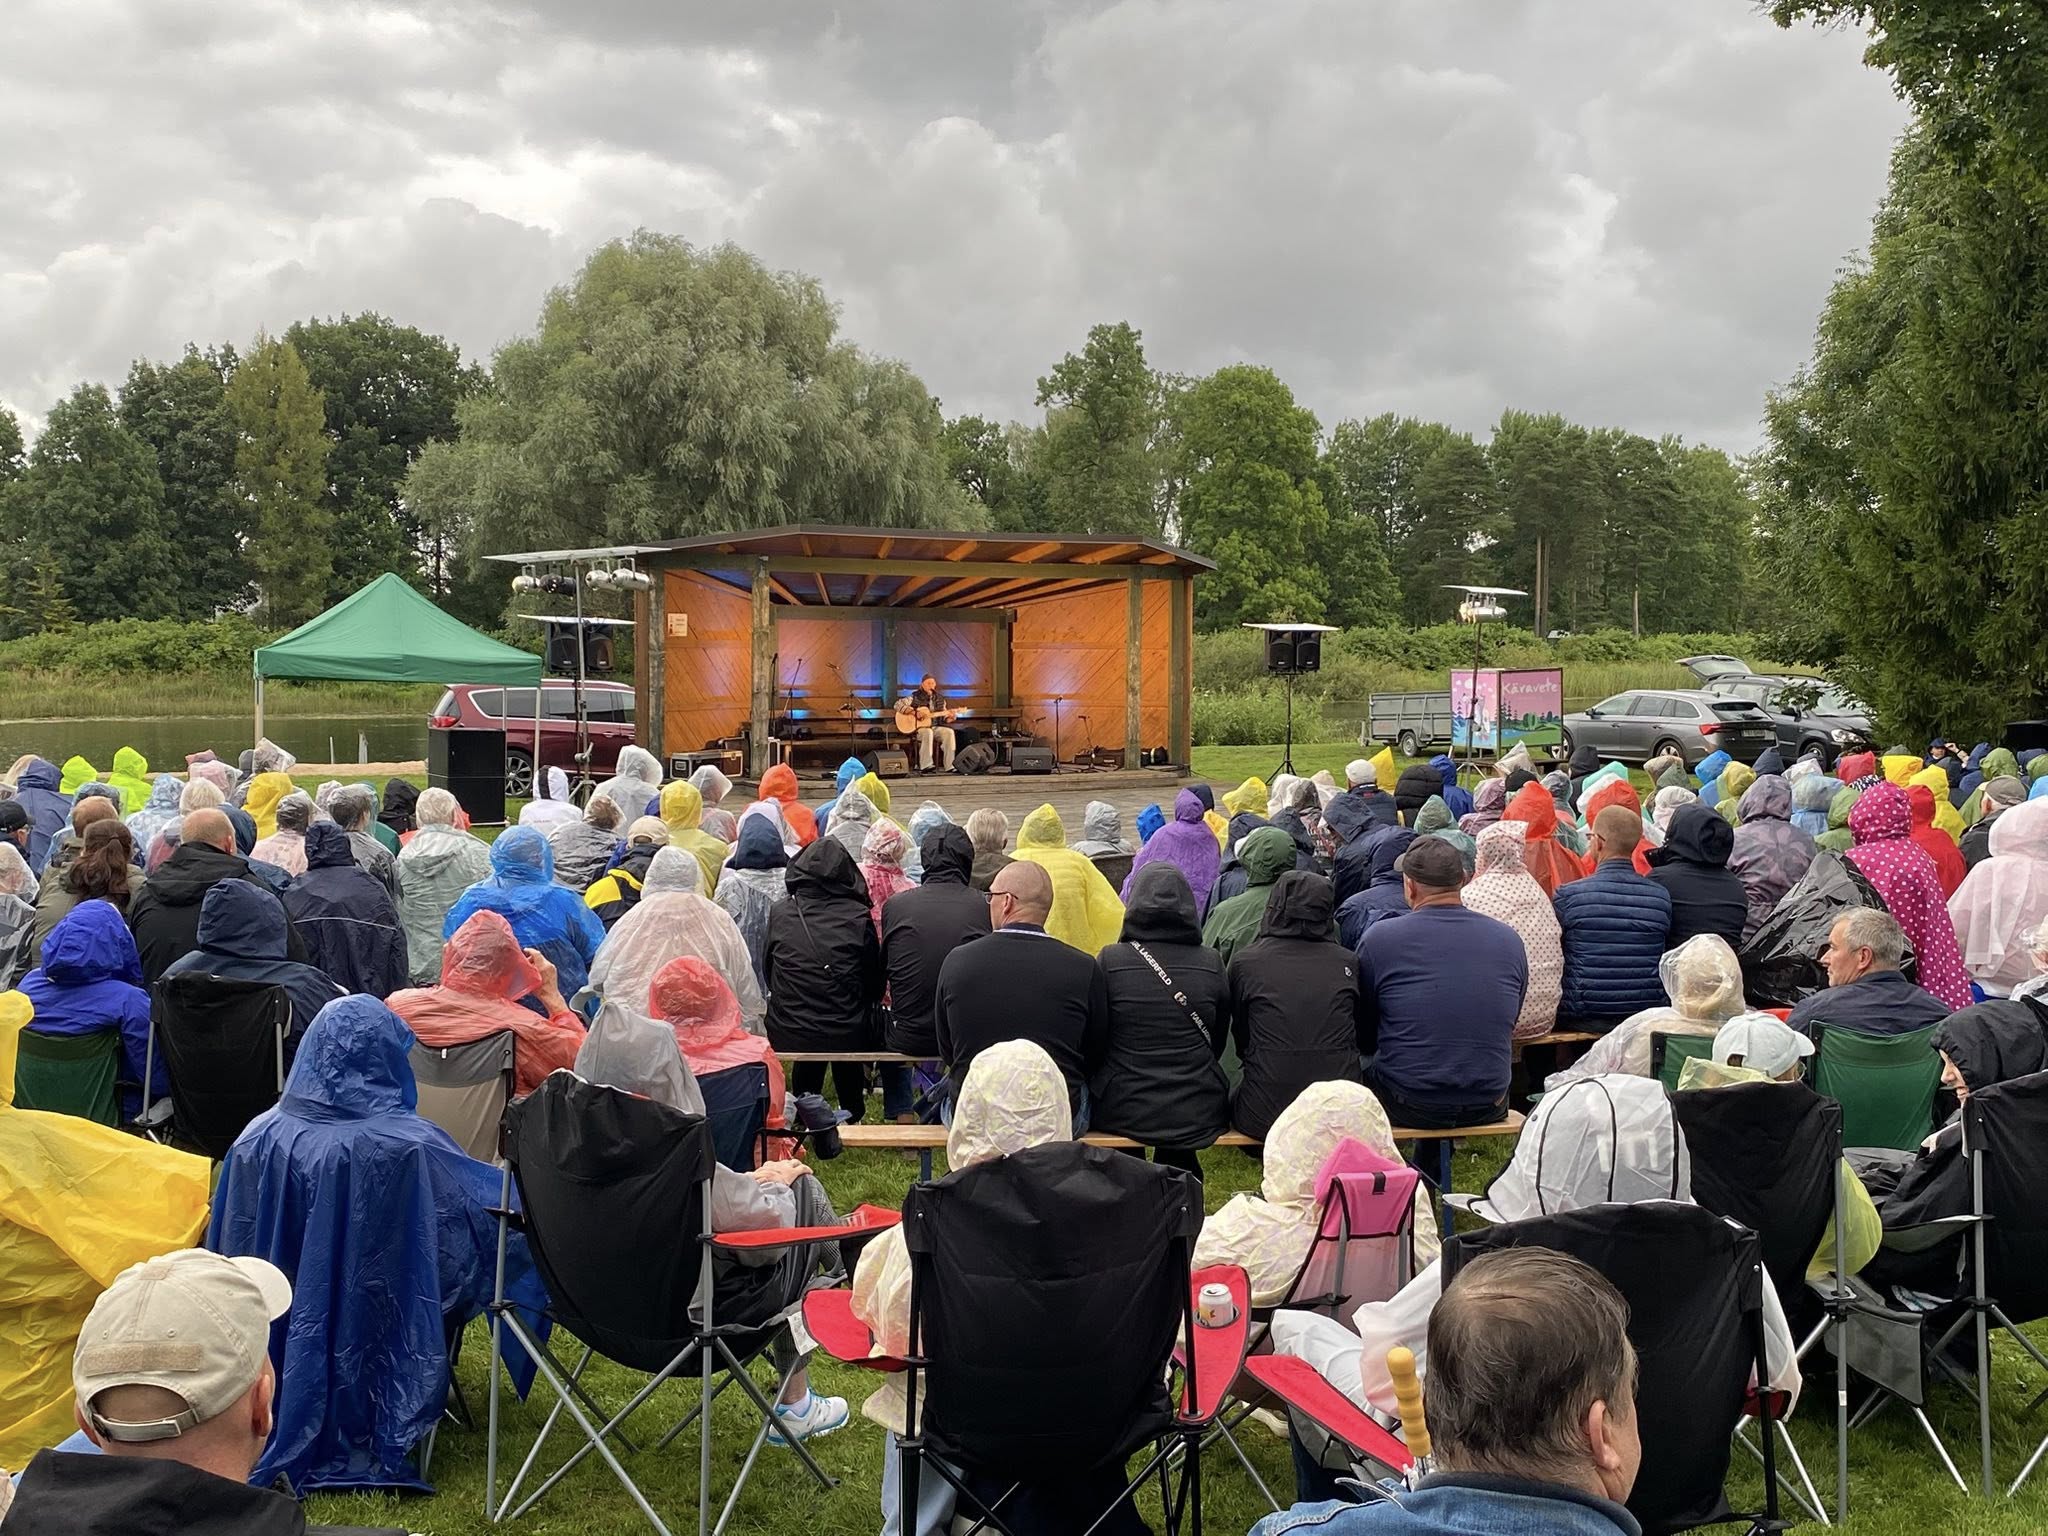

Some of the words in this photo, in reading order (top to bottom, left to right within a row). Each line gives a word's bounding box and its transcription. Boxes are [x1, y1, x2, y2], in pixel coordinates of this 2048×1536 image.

[1502, 677, 1558, 694] Käravete
[1139, 948, 1172, 985] LAGERFELD
[1190, 1011, 1204, 1029] KARL
